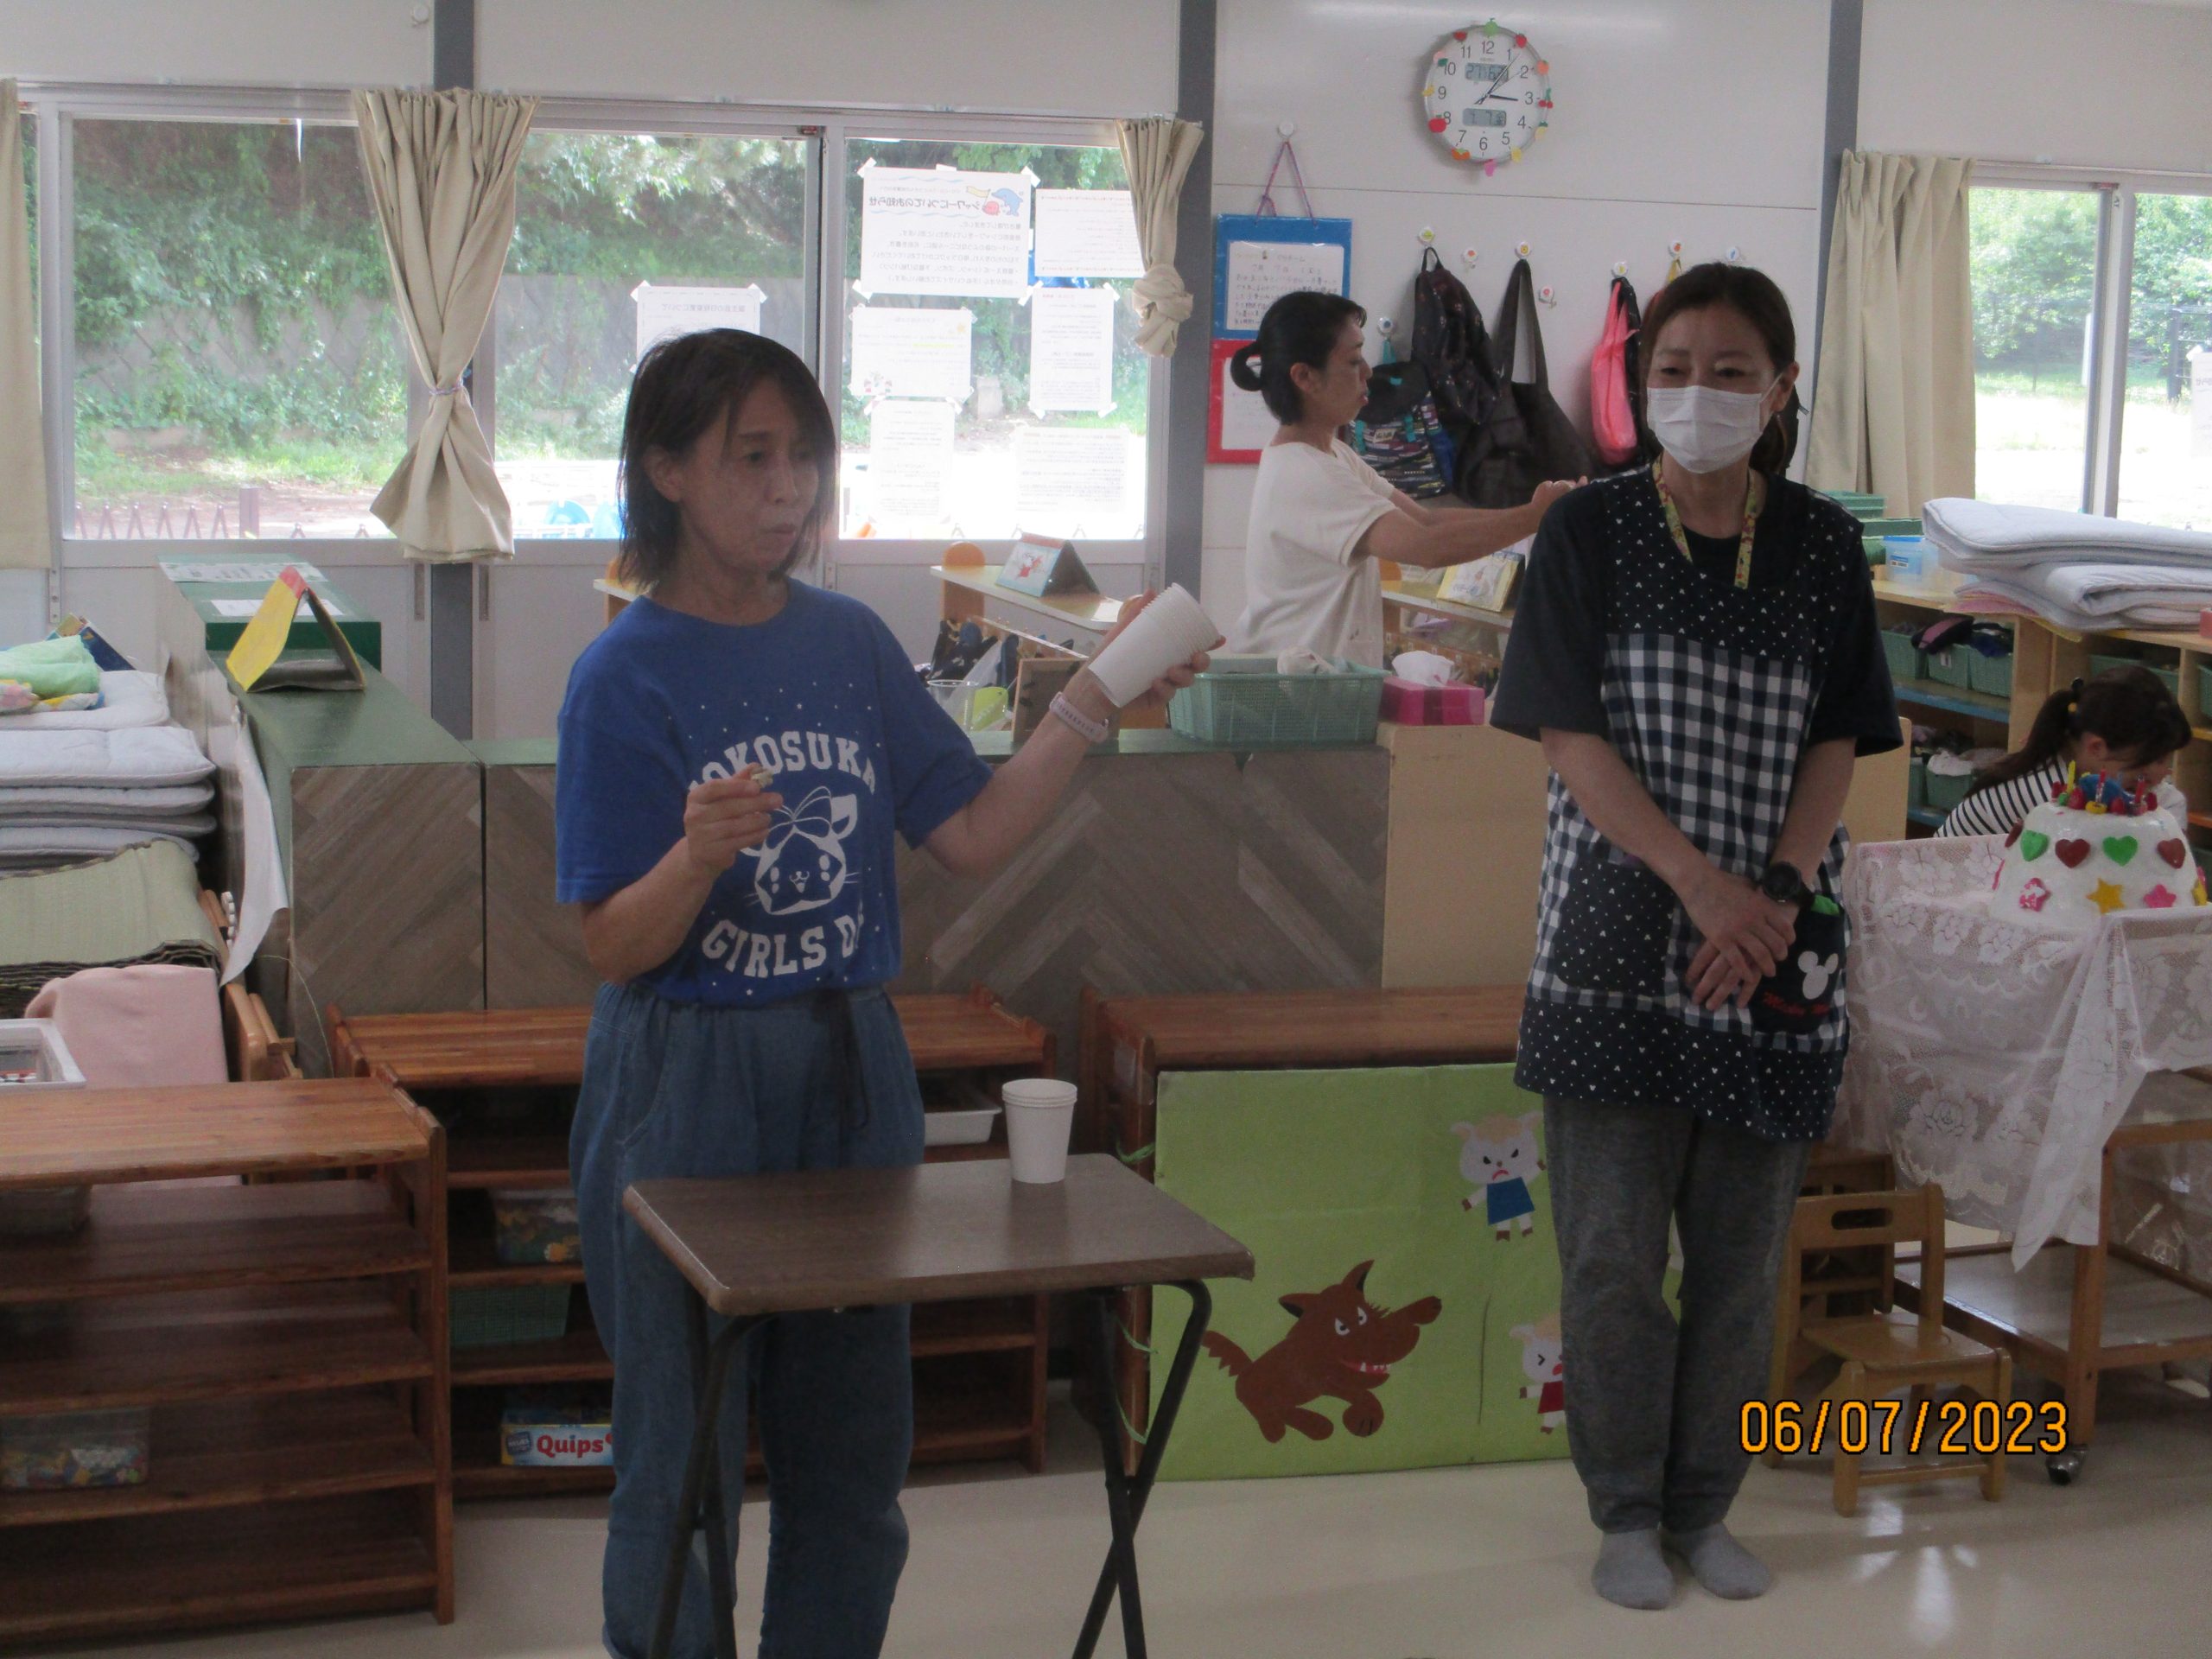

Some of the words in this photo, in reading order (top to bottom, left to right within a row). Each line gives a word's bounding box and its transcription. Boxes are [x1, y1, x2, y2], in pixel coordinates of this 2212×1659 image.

[1461, 47, 1471, 59] 11
[1481, 41, 1495, 54] 12
[1507, 48, 1511, 60] 1
[1444, 61, 1456, 75] 10
[1520, 65, 1529, 79] 2
[1438, 86, 1446, 99] 9
[1524, 92, 1534, 105] 3
[1443, 111, 1452, 124] 8
[1517, 116, 1526, 129] 4
[1459, 130, 1466, 143] 7
[1501, 131, 1510, 145] 5
[1479, 137, 1488, 150] 6
[689, 731, 875, 794] OKOSUKA
[702, 918, 827, 978] GIRLS
[834, 900, 864, 958] D
[537, 1434, 604, 1458] Quips
